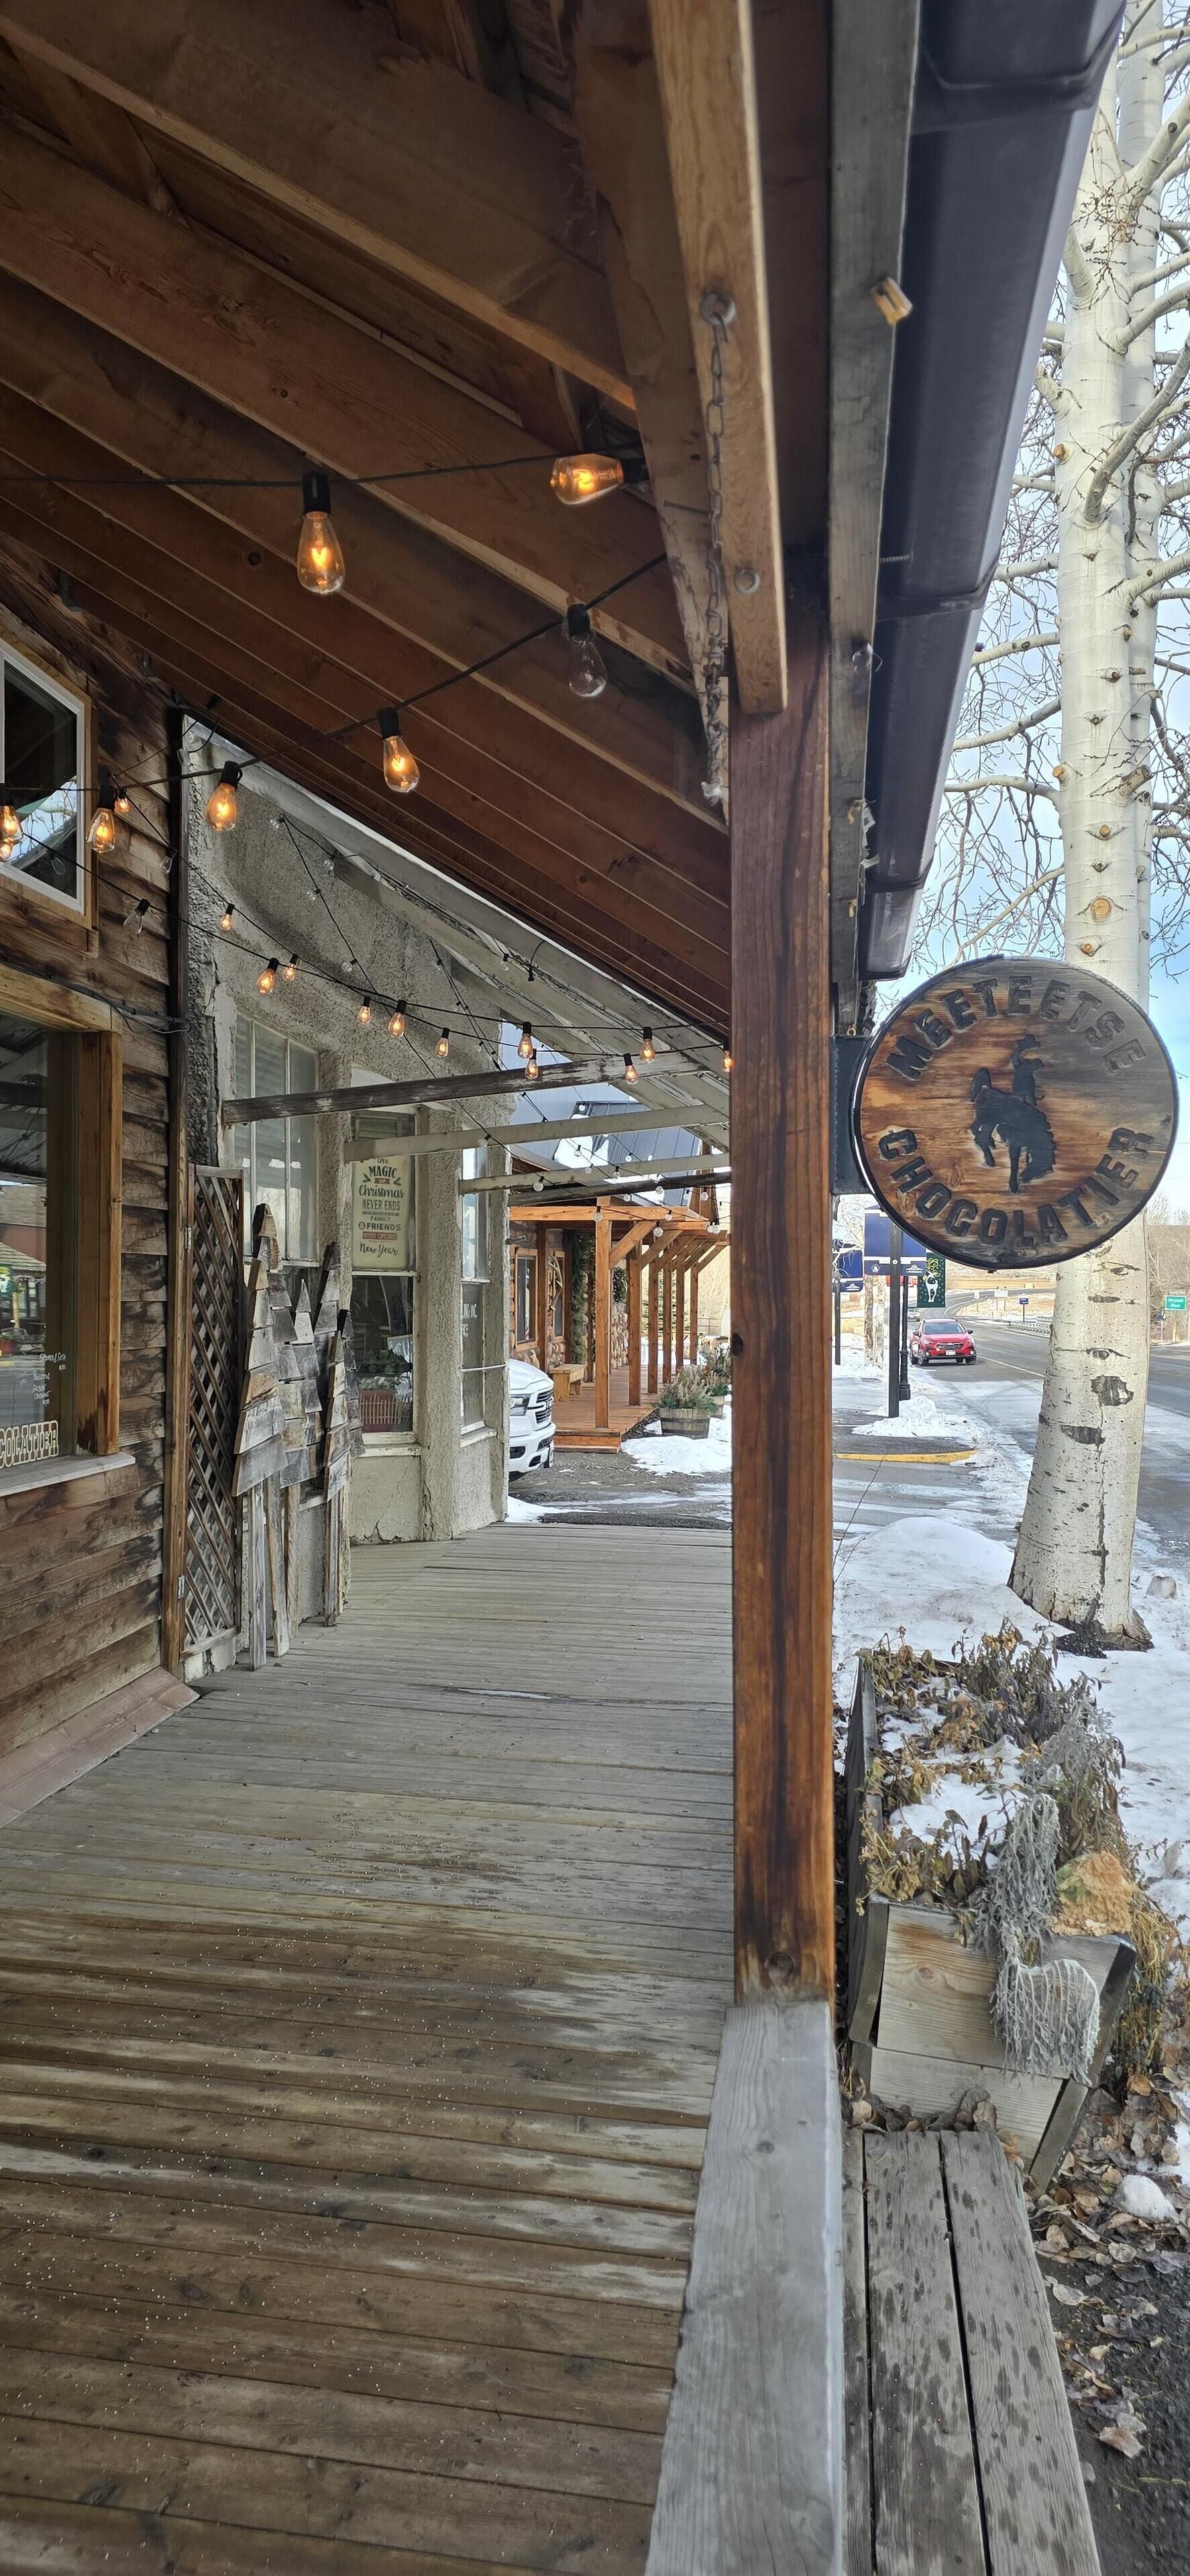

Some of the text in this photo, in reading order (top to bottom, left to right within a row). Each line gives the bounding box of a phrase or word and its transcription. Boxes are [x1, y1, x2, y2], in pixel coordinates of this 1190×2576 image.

[885, 975, 1146, 1081] MEETEETSE
[368, 1165, 397, 1179] MAGIC
[359, 1185, 404, 1199] Christmas
[878, 1127, 1154, 1246] CHOCOLATIER
[363, 1199, 400, 1211] NEVER ENDS
[366, 1222, 401, 1231] FRIENDS
[360, 1242, 398, 1258] New Year
